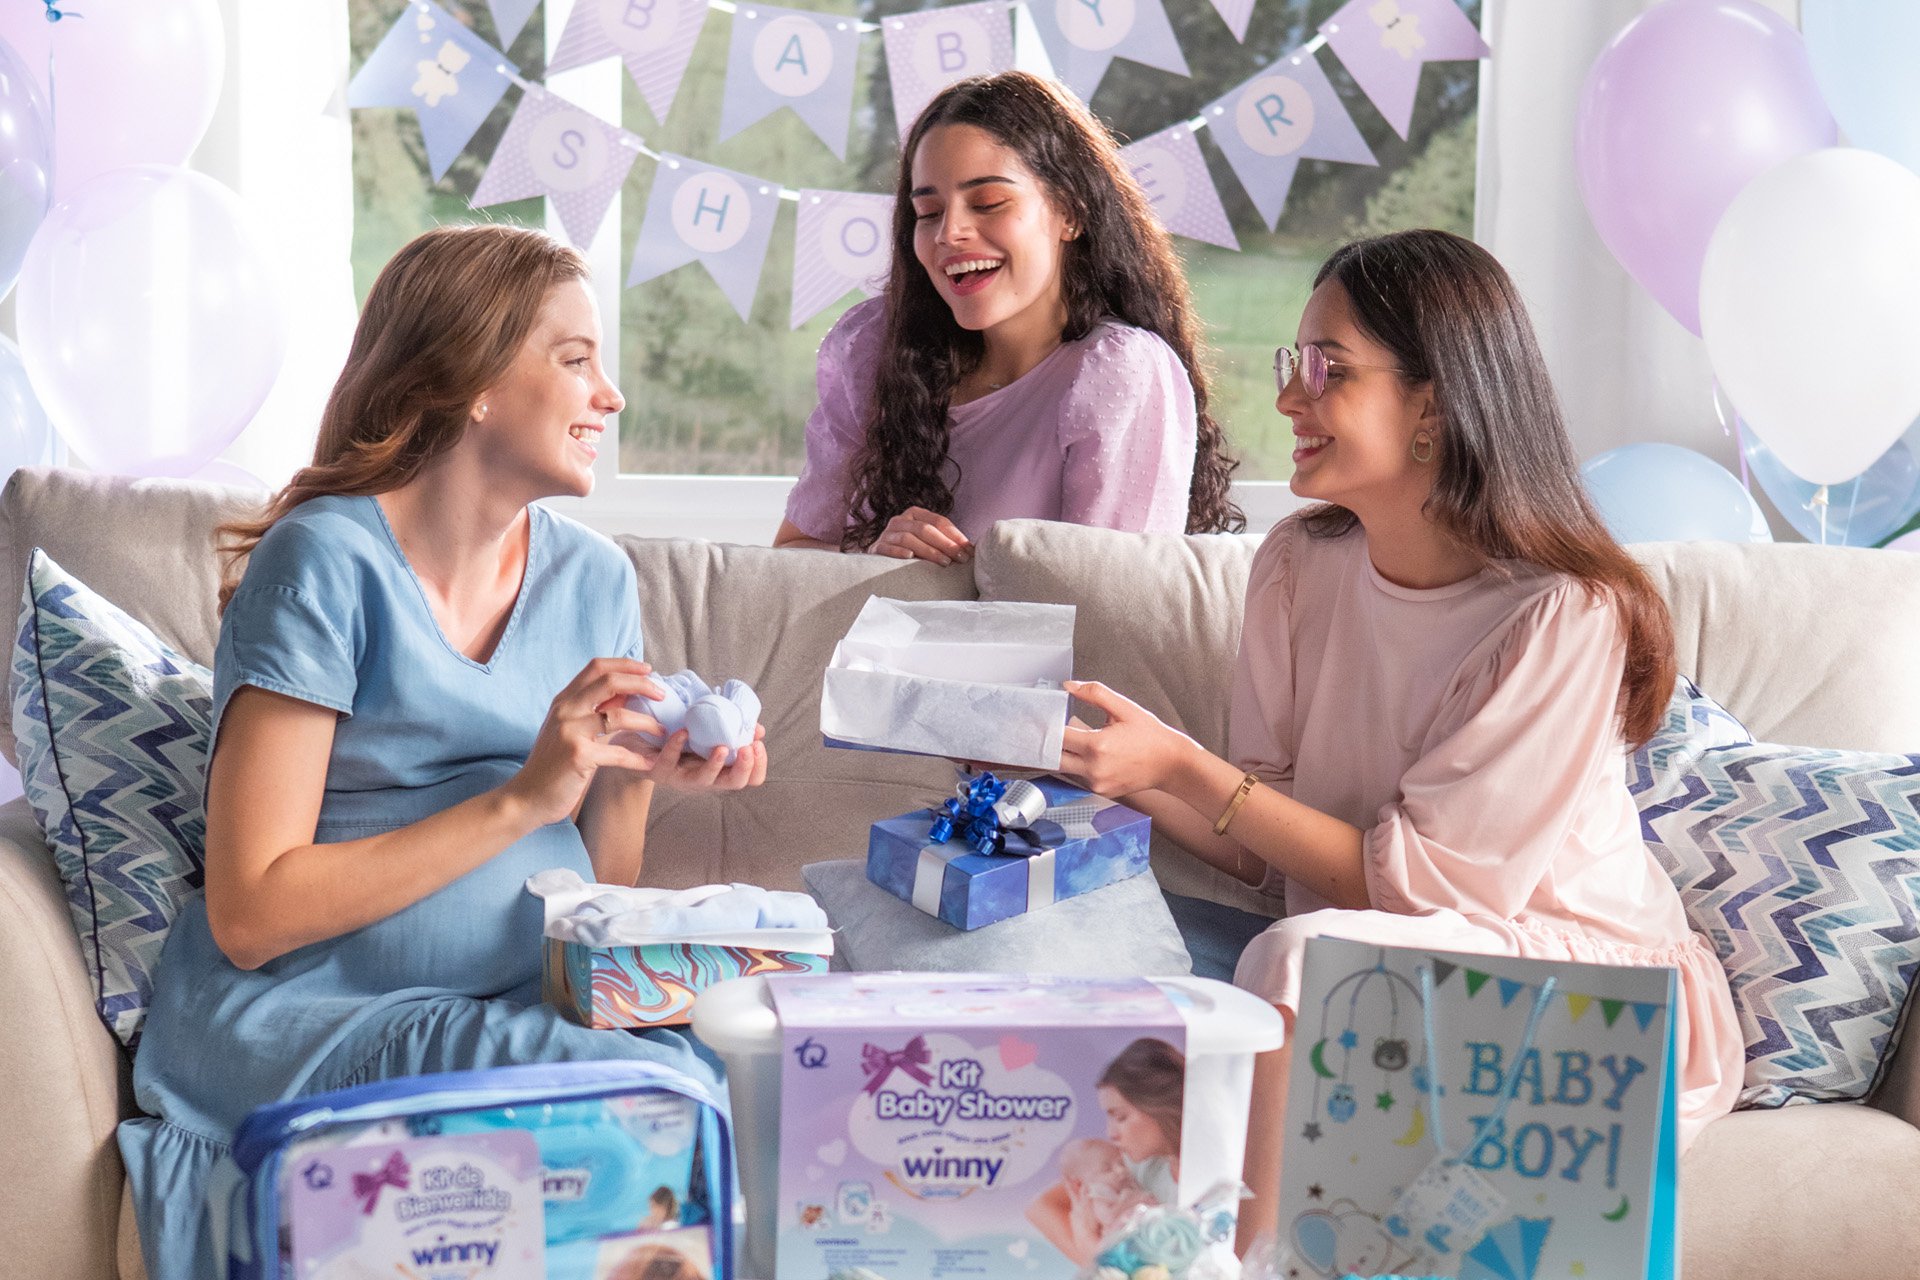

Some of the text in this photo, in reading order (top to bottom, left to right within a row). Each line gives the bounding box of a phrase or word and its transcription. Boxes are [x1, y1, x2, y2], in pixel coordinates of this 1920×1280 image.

[774, 33, 809, 77] A
[936, 31, 968, 74] B
[552, 129, 586, 171] S
[692, 186, 731, 234] H
[1253, 92, 1294, 137] R
[939, 1059, 984, 1090] Kit
[1461, 1041, 1648, 1112] BABY
[878, 1089, 1072, 1127] Baby Shower
[903, 1147, 1004, 1186] winny
[1467, 1114, 1624, 1190] BOY!
[412, 1234, 500, 1266] winny
